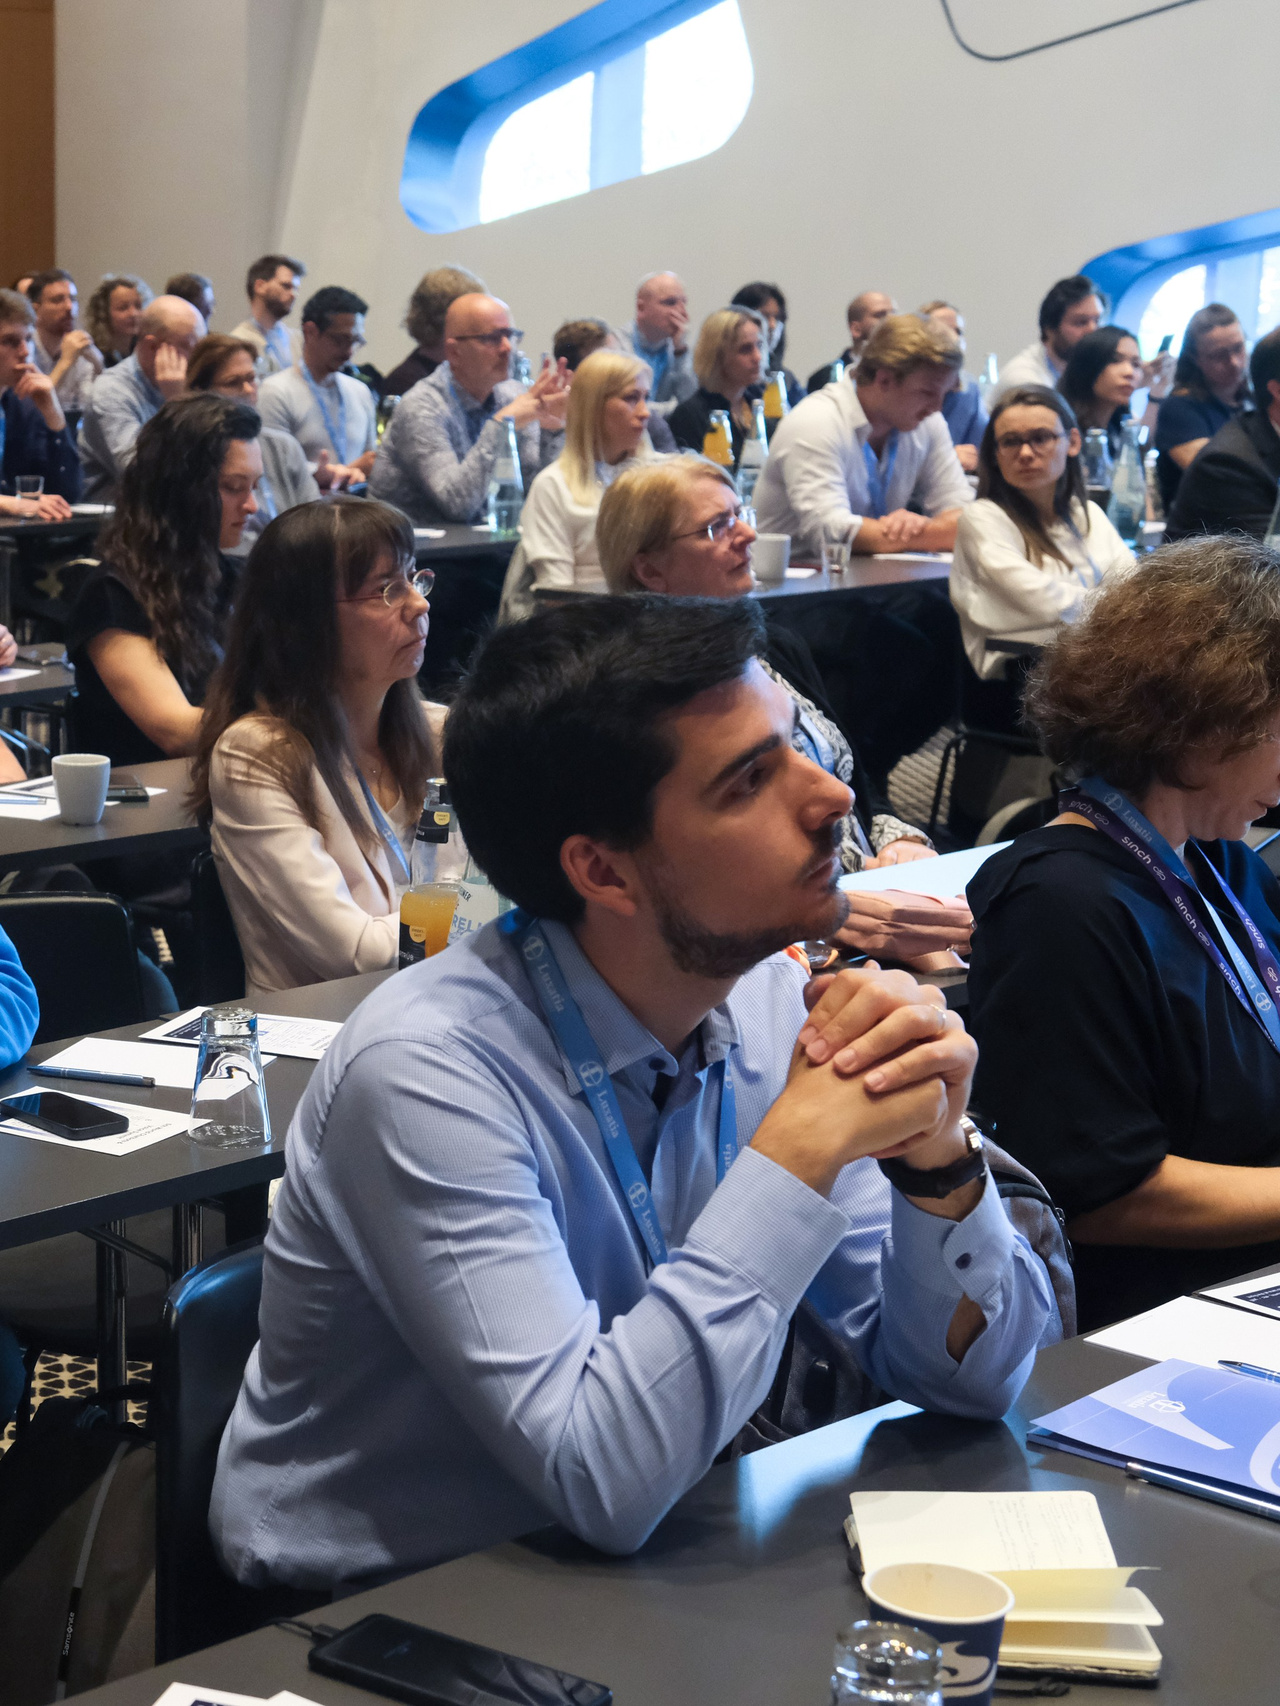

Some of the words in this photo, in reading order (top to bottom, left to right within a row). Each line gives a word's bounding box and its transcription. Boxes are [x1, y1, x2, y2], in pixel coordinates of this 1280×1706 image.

[1123, 809, 1153, 843] Luxatia
[1121, 836, 1152, 865] sinch
[1174, 895, 1197, 930] sinch
[1245, 917, 1265, 949] sinch
[537, 964, 565, 1013] Luxatia
[1219, 961, 1241, 997] sinch
[1234, 952, 1257, 989] Luxatia
[595, 1089, 620, 1139] Luxatia
[642, 1208, 663, 1257] Luxatia
